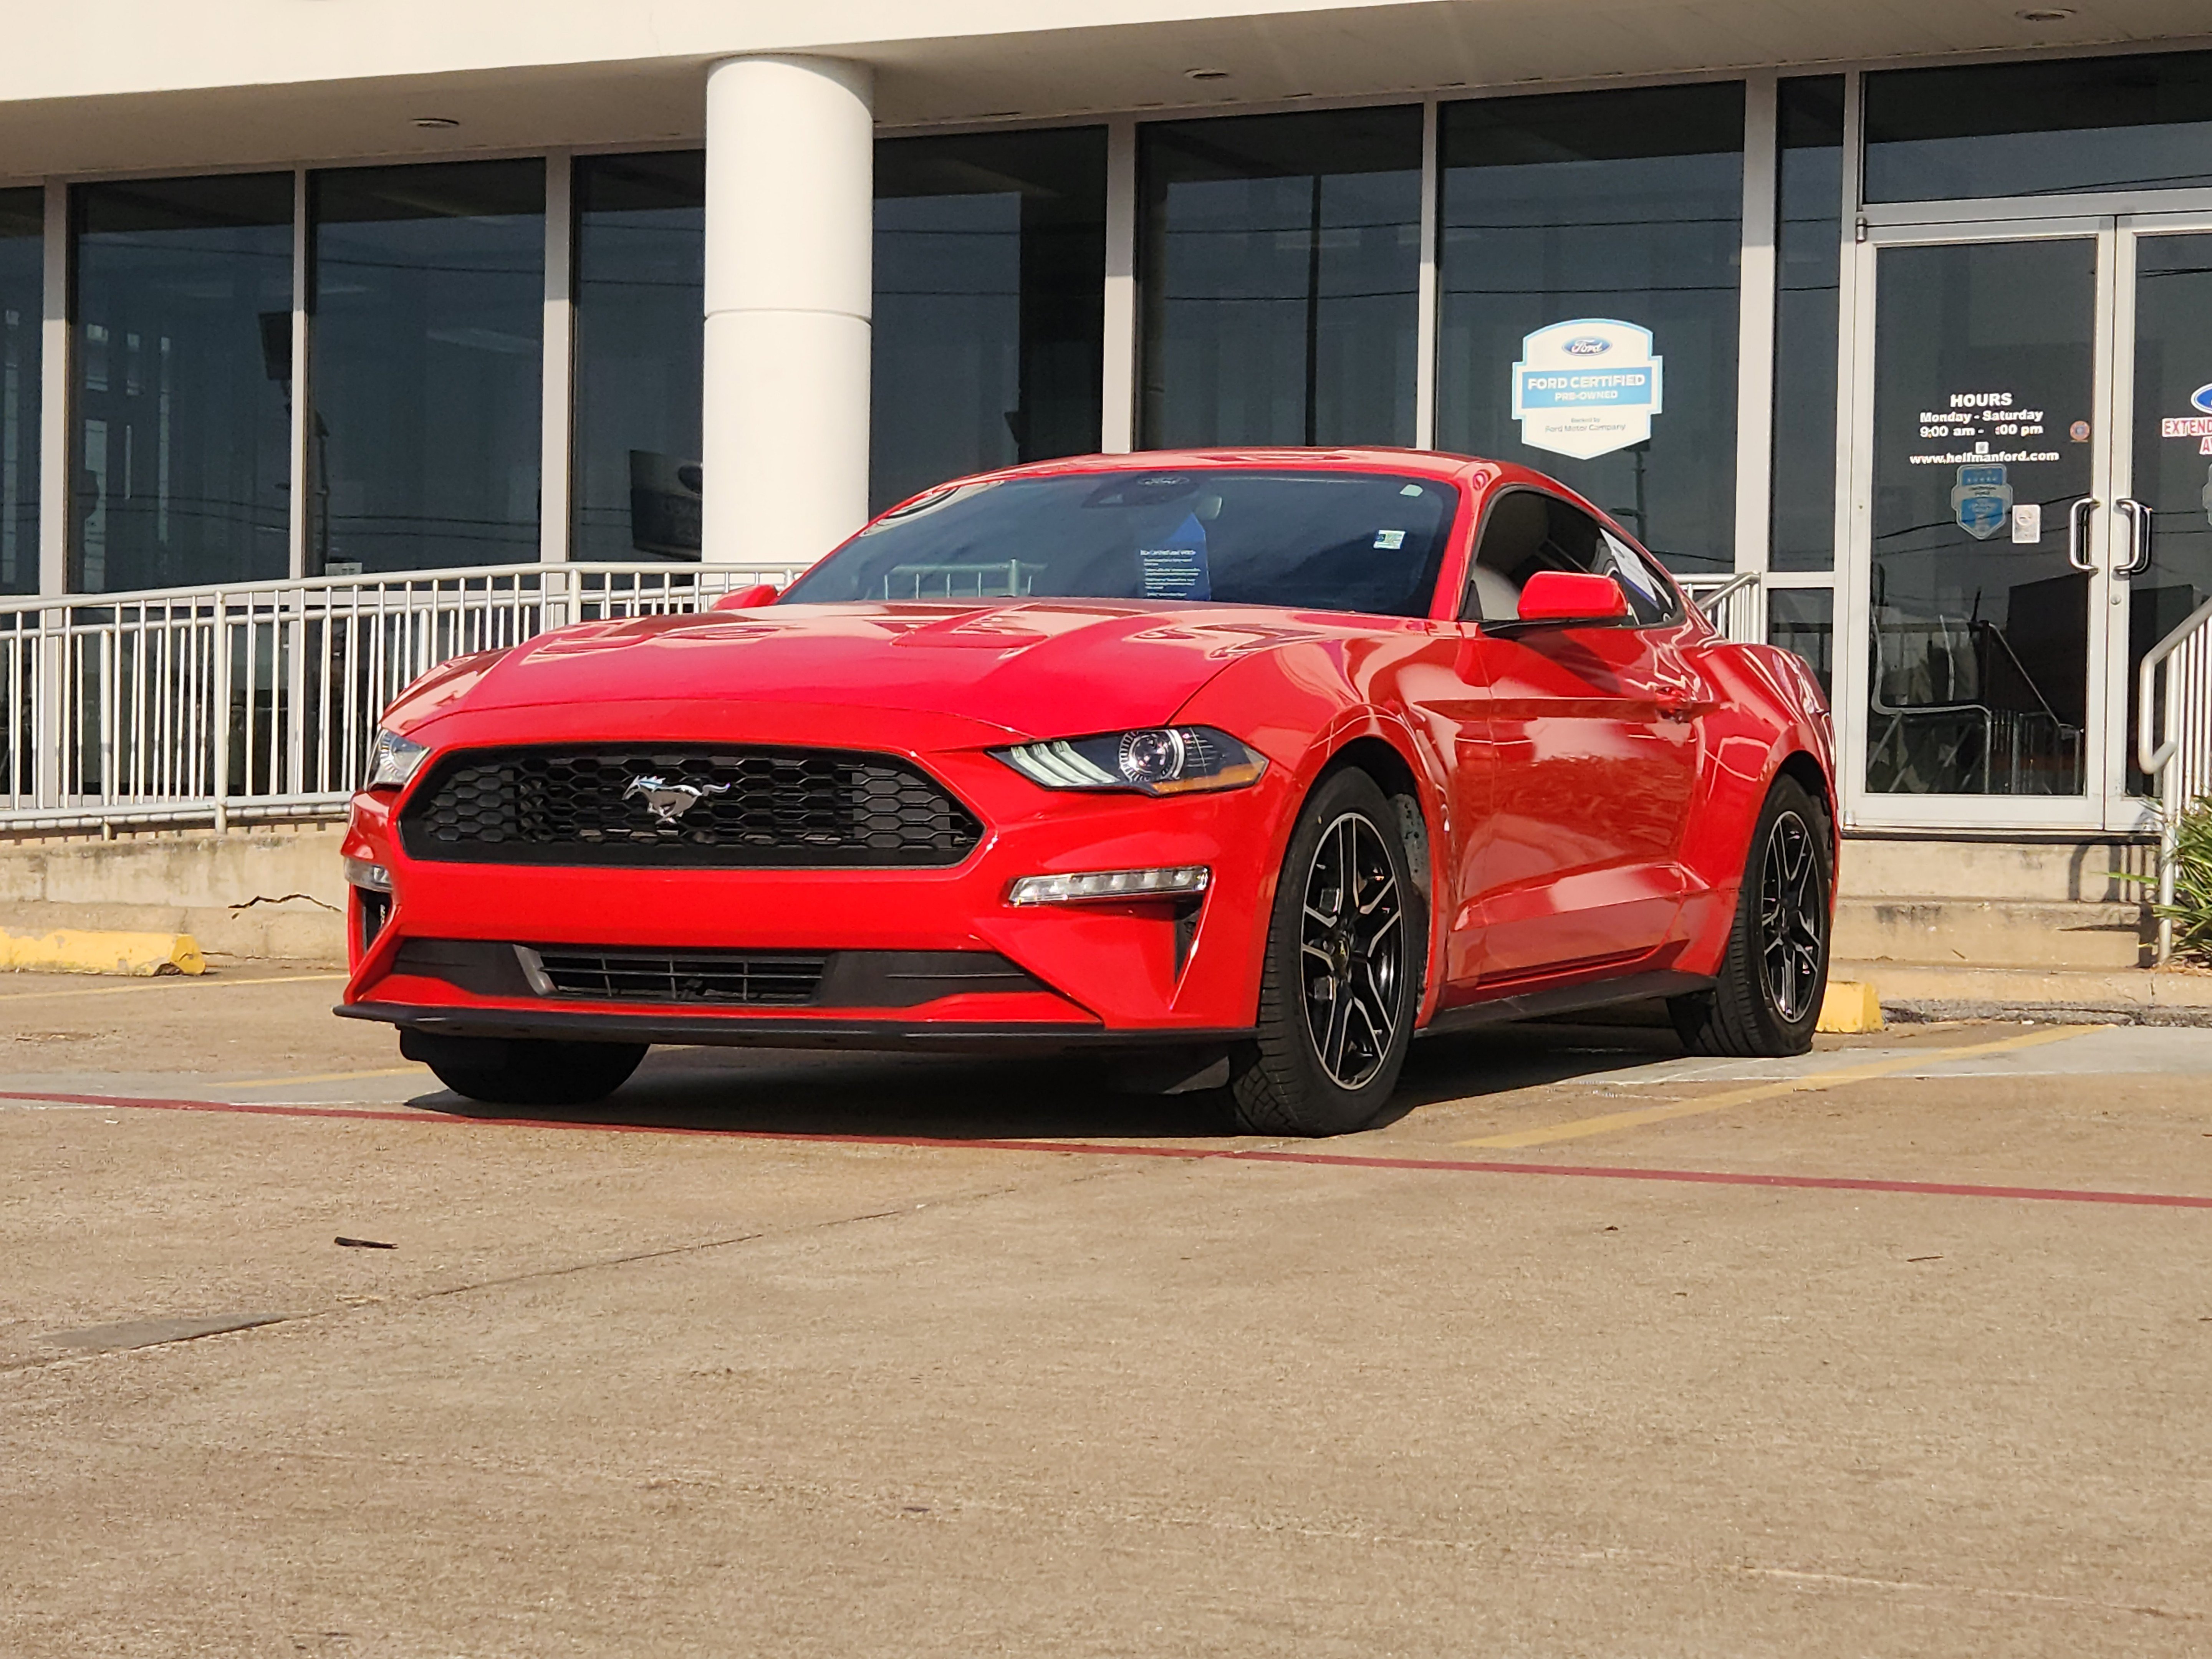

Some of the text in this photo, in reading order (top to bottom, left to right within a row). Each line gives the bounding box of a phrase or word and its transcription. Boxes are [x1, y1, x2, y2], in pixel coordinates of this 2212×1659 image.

[1571, 339, 1603, 353] Ford
[1528, 374, 1645, 390] FORD CERTIFIED
[1555, 391, 1618, 401] PRE-OWNED
[1950, 392, 2013, 407] HOURS
[1920, 412, 1972, 424] Monday
[1982, 409, 2043, 422] Saturday
[1920, 426, 1949, 438] 9:00
[1953, 427, 1975, 436] am
[2020, 426, 2043, 437] pm
